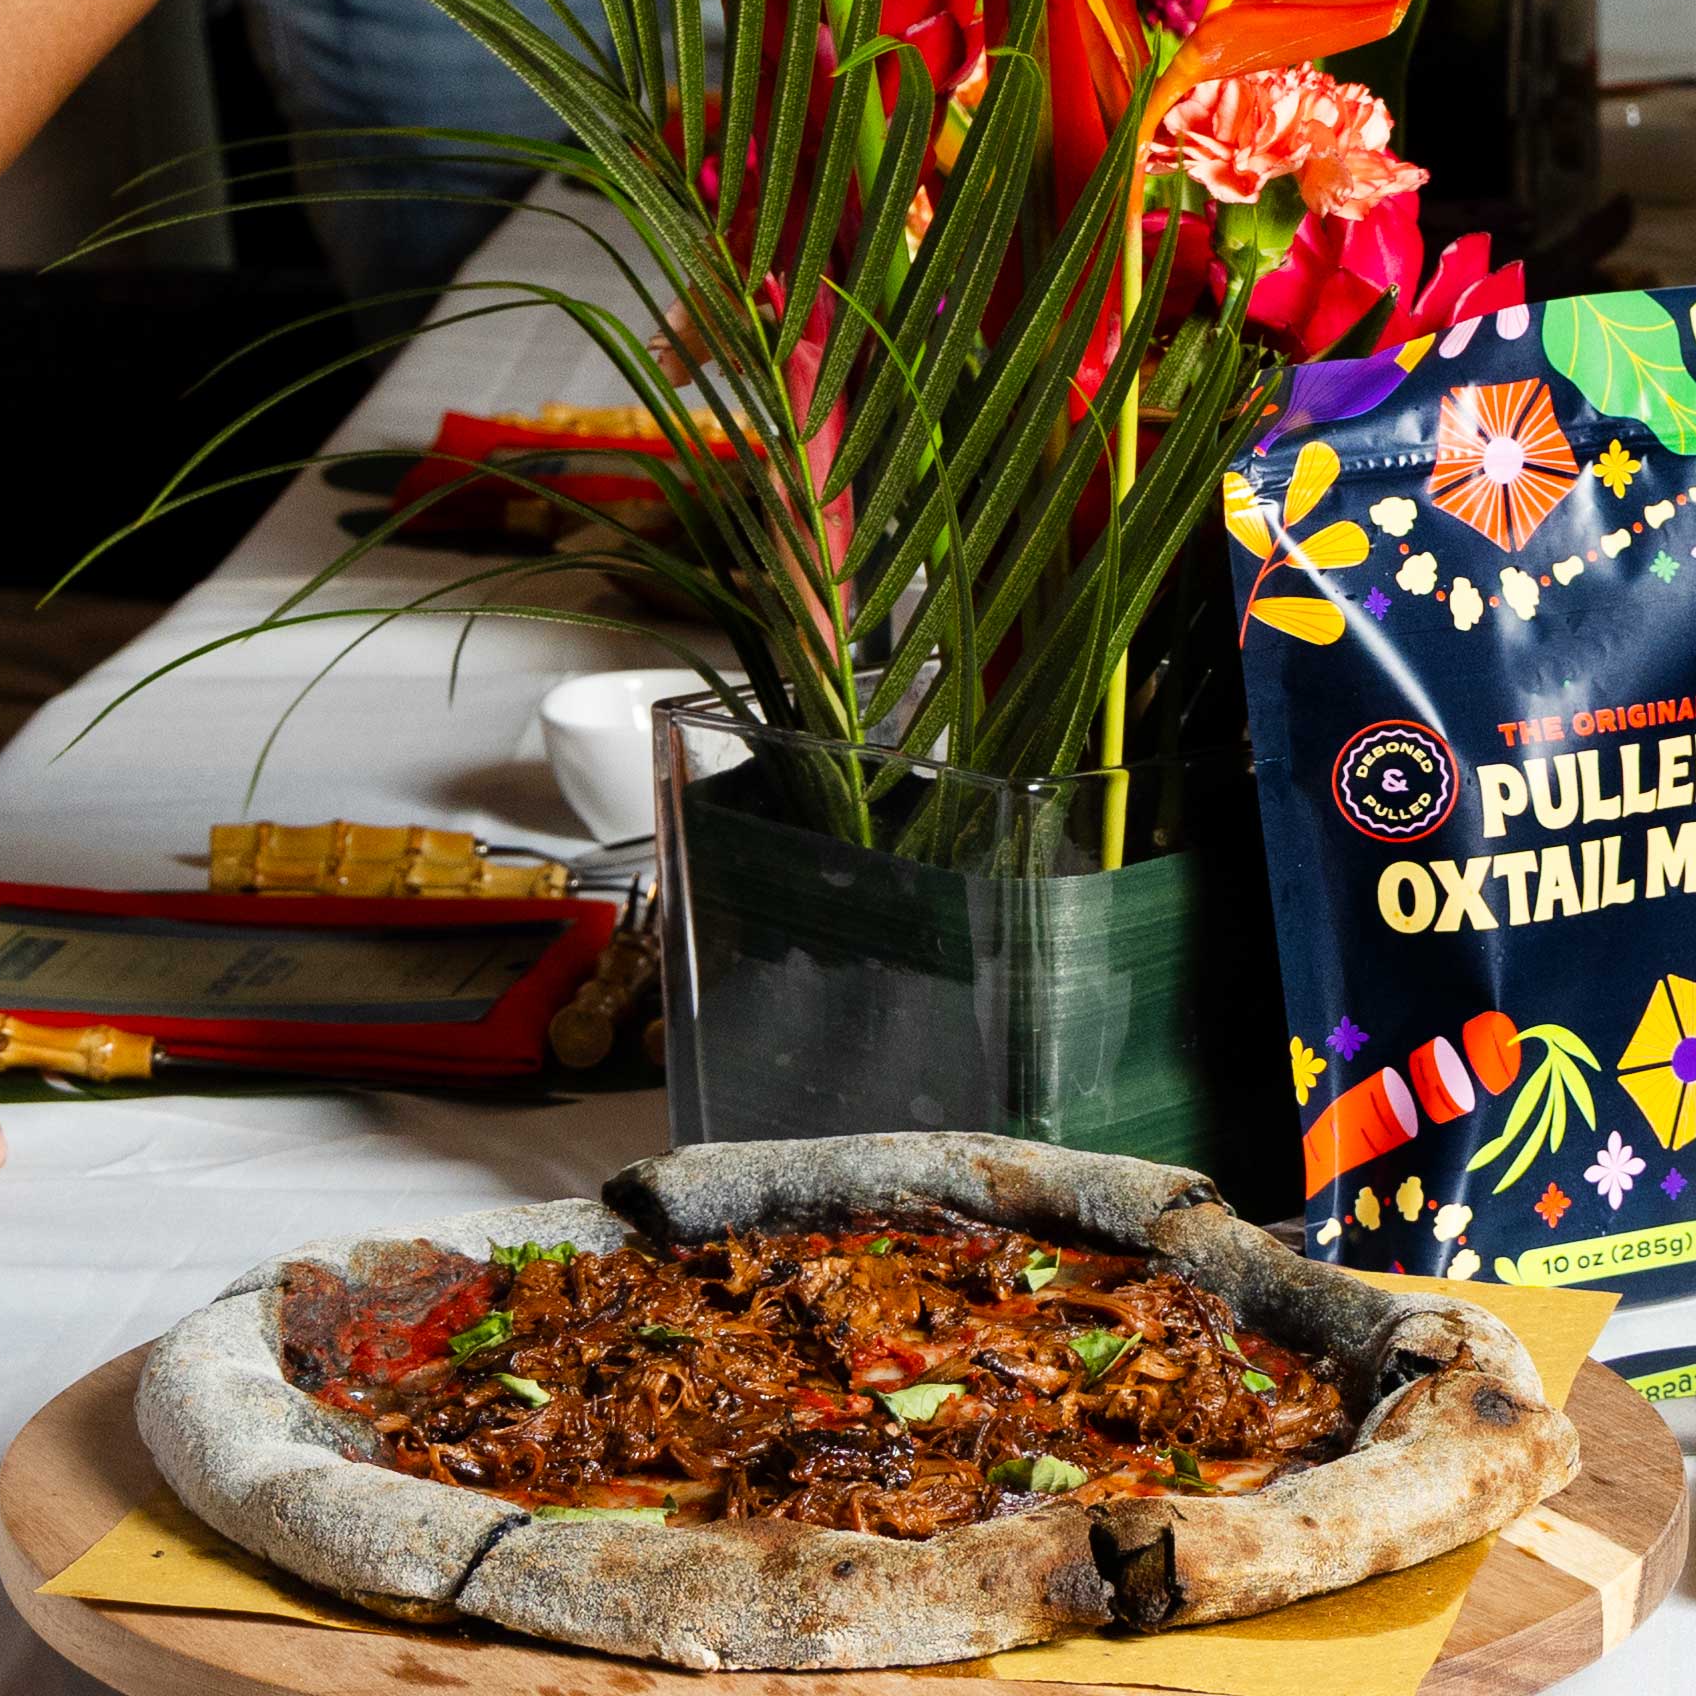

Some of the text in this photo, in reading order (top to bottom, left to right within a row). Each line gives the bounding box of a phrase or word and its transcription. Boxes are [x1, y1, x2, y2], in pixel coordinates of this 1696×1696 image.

[1497, 716, 1565, 747] THE
[1356, 742, 1433, 778] DEBONED
[1382, 768, 1408, 792] &
[1362, 793, 1431, 820] PULLED
[1377, 835, 1635, 934] OXTAIL
[1542, 1232, 1692, 1274] 10 oz (285g)
